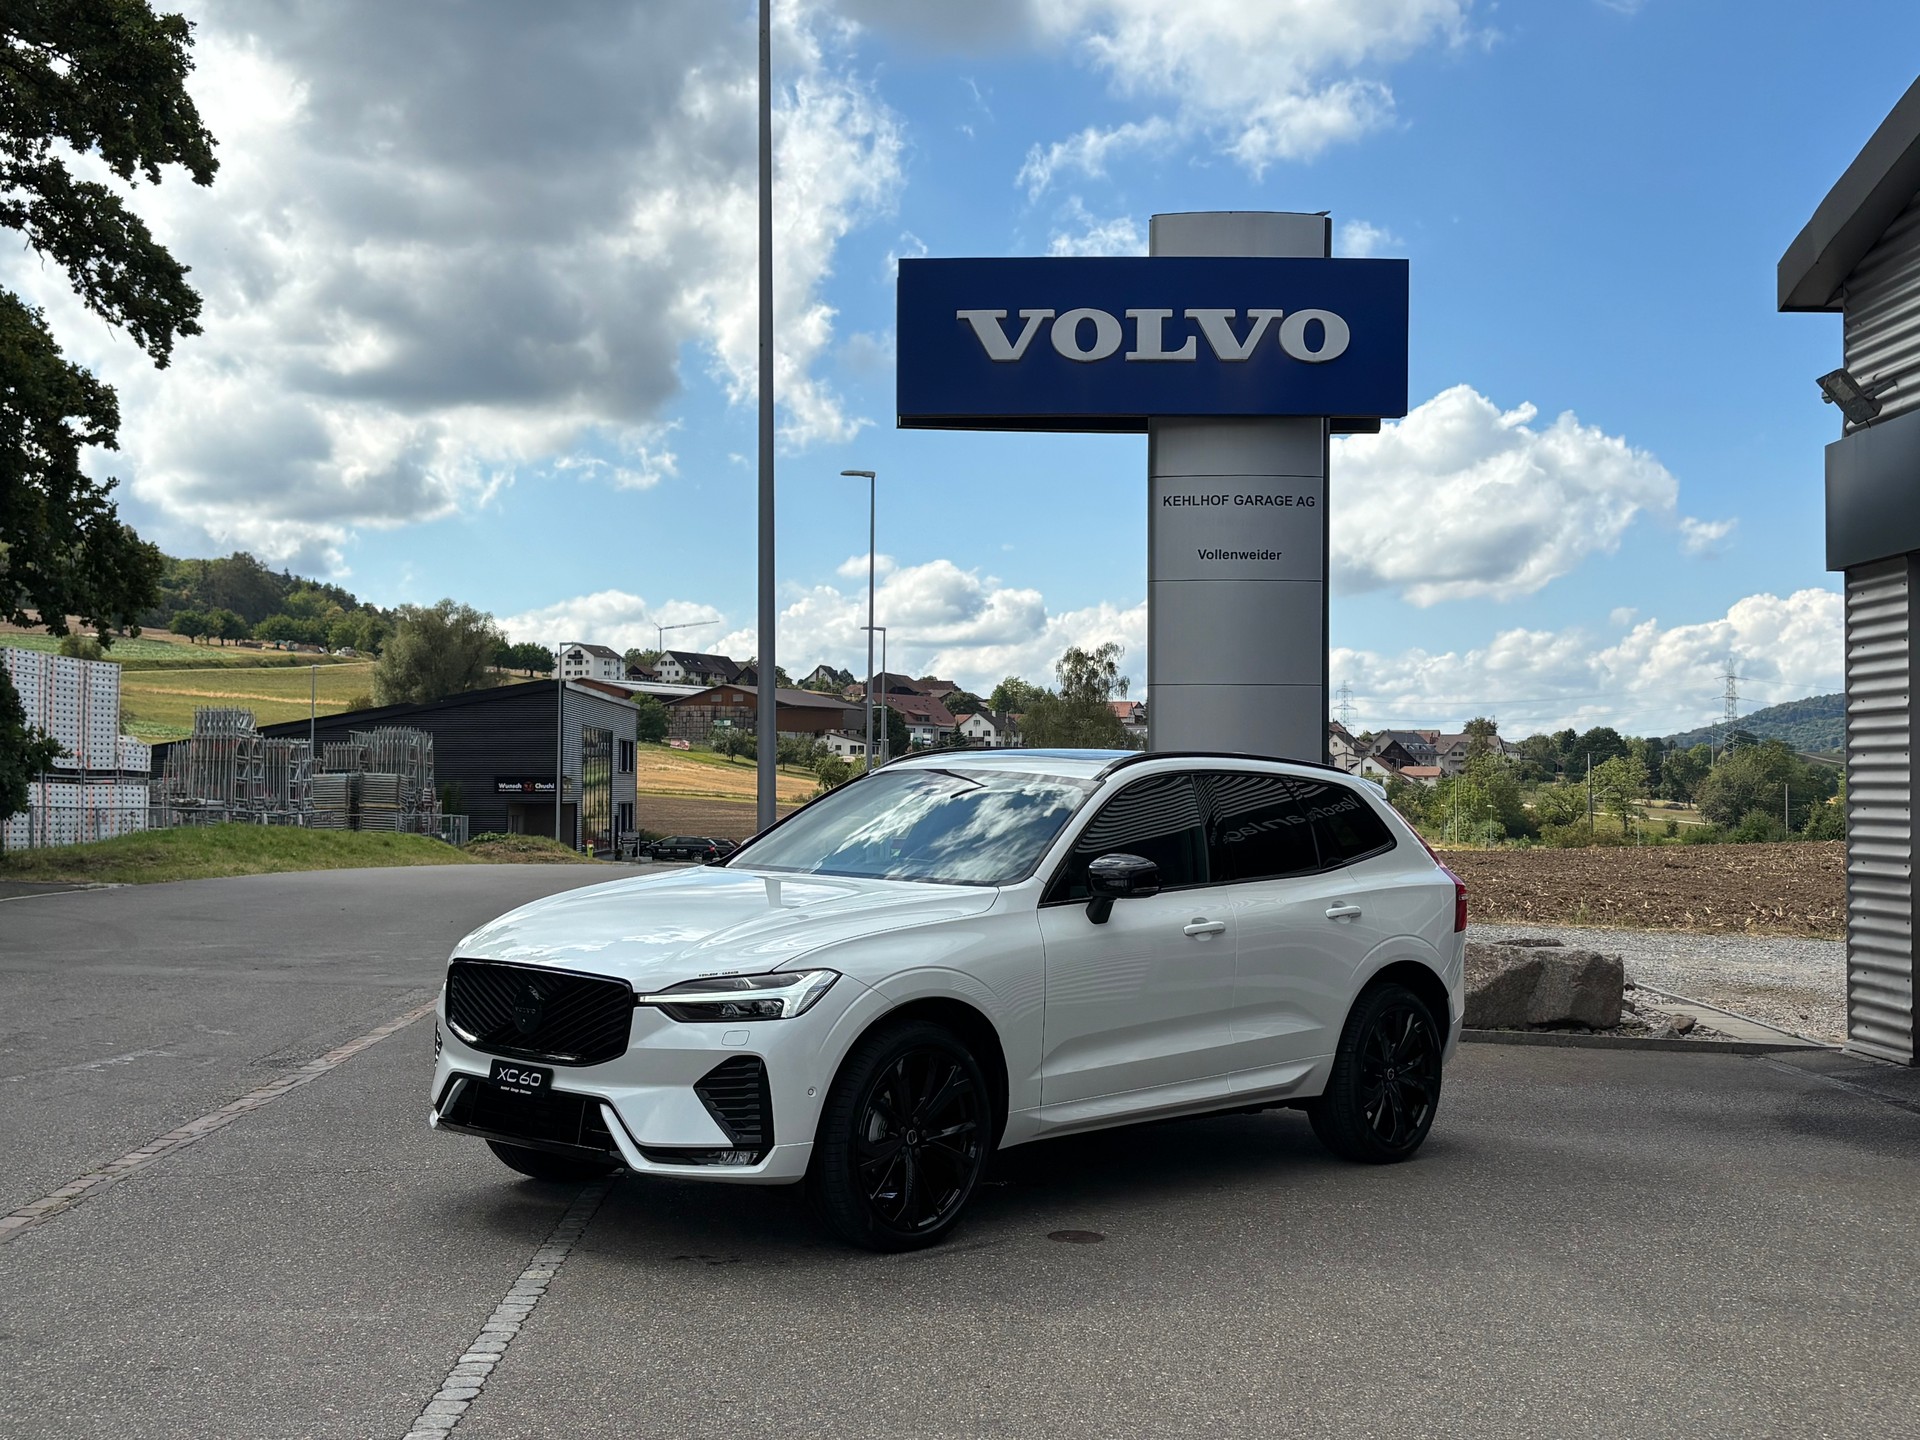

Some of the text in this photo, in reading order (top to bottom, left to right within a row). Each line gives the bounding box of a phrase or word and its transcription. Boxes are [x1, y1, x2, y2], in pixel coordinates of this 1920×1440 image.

[956, 307, 1351, 363] VOLVO
[1162, 494, 1315, 507] KEHLHOF GARAGE AG
[1197, 549, 1282, 561] Vollenweider
[496, 1067, 542, 1087] XC60
